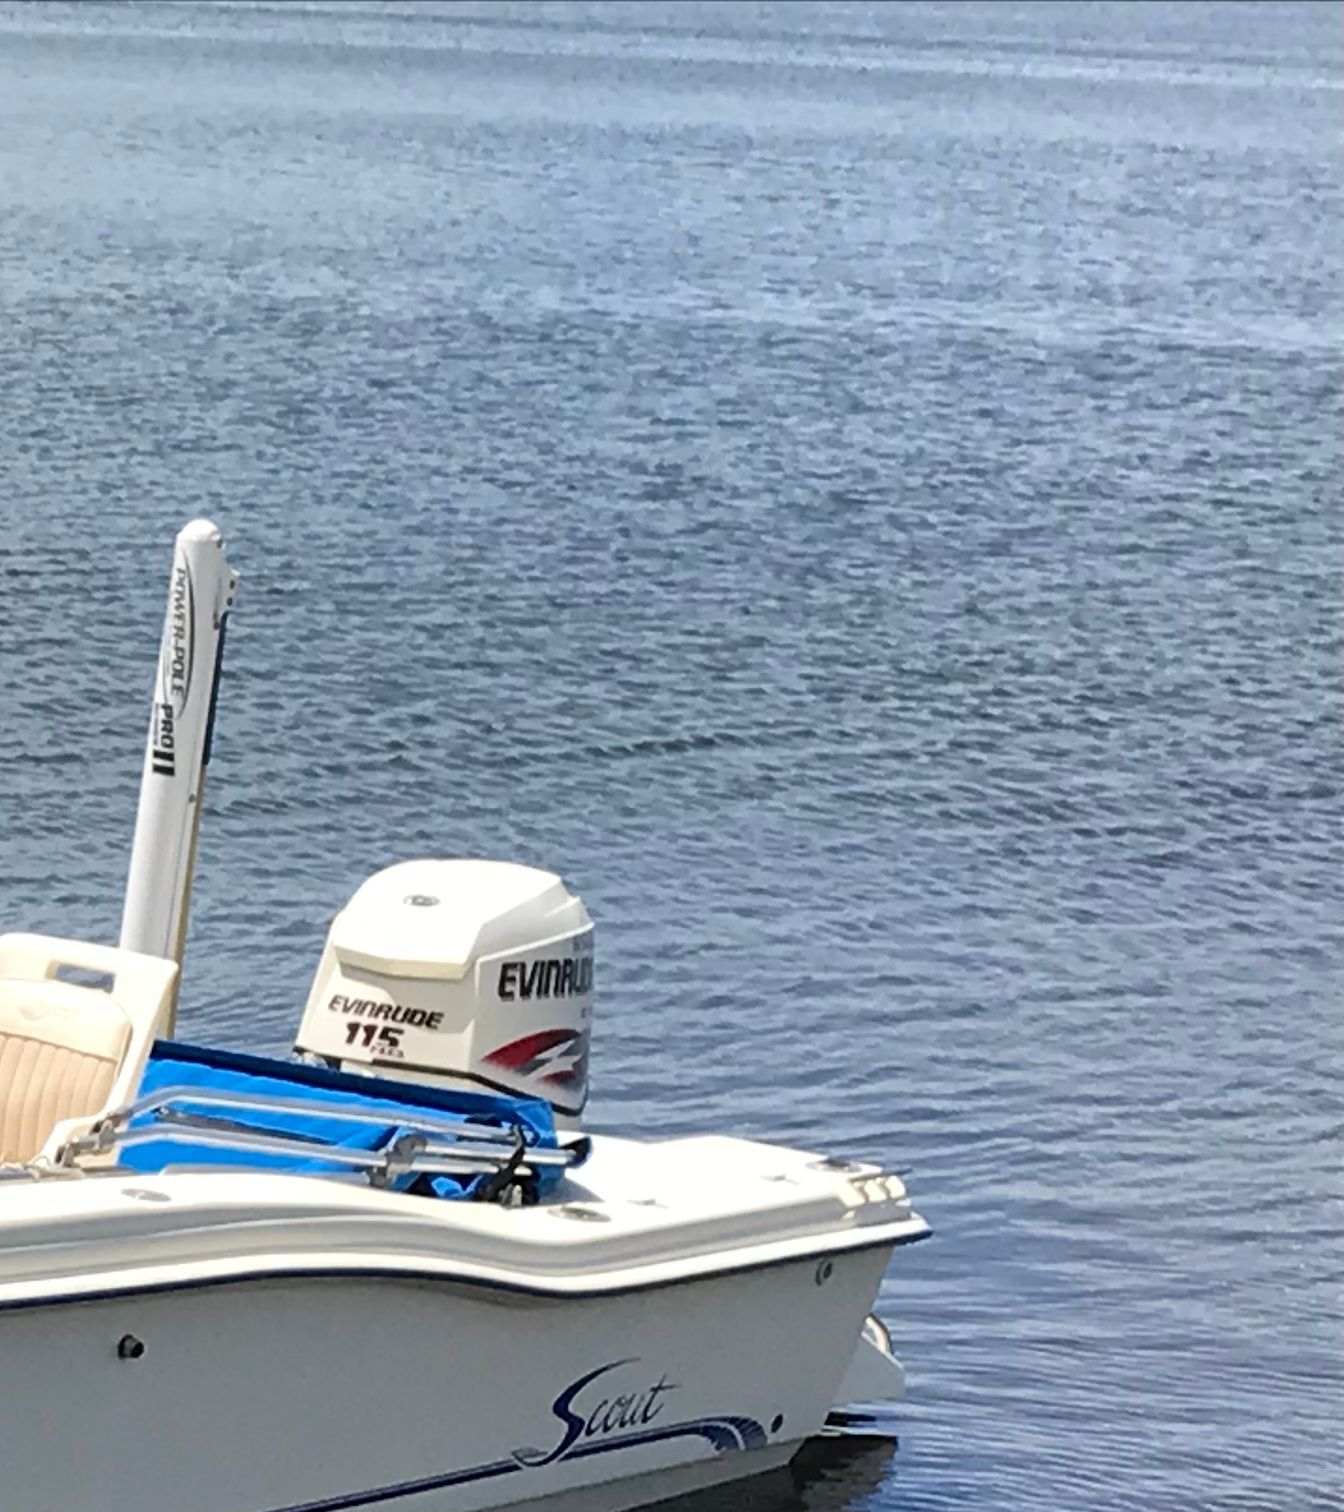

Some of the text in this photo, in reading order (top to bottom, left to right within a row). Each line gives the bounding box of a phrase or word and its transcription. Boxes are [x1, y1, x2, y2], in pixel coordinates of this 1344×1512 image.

[171, 567, 186, 697] POWER-POLE
[160, 704, 175, 749] PRO
[328, 994, 445, 1031] EVINRUDE
[345, 1022, 405, 1048] 115
[511, 1356, 682, 1469] Scout
